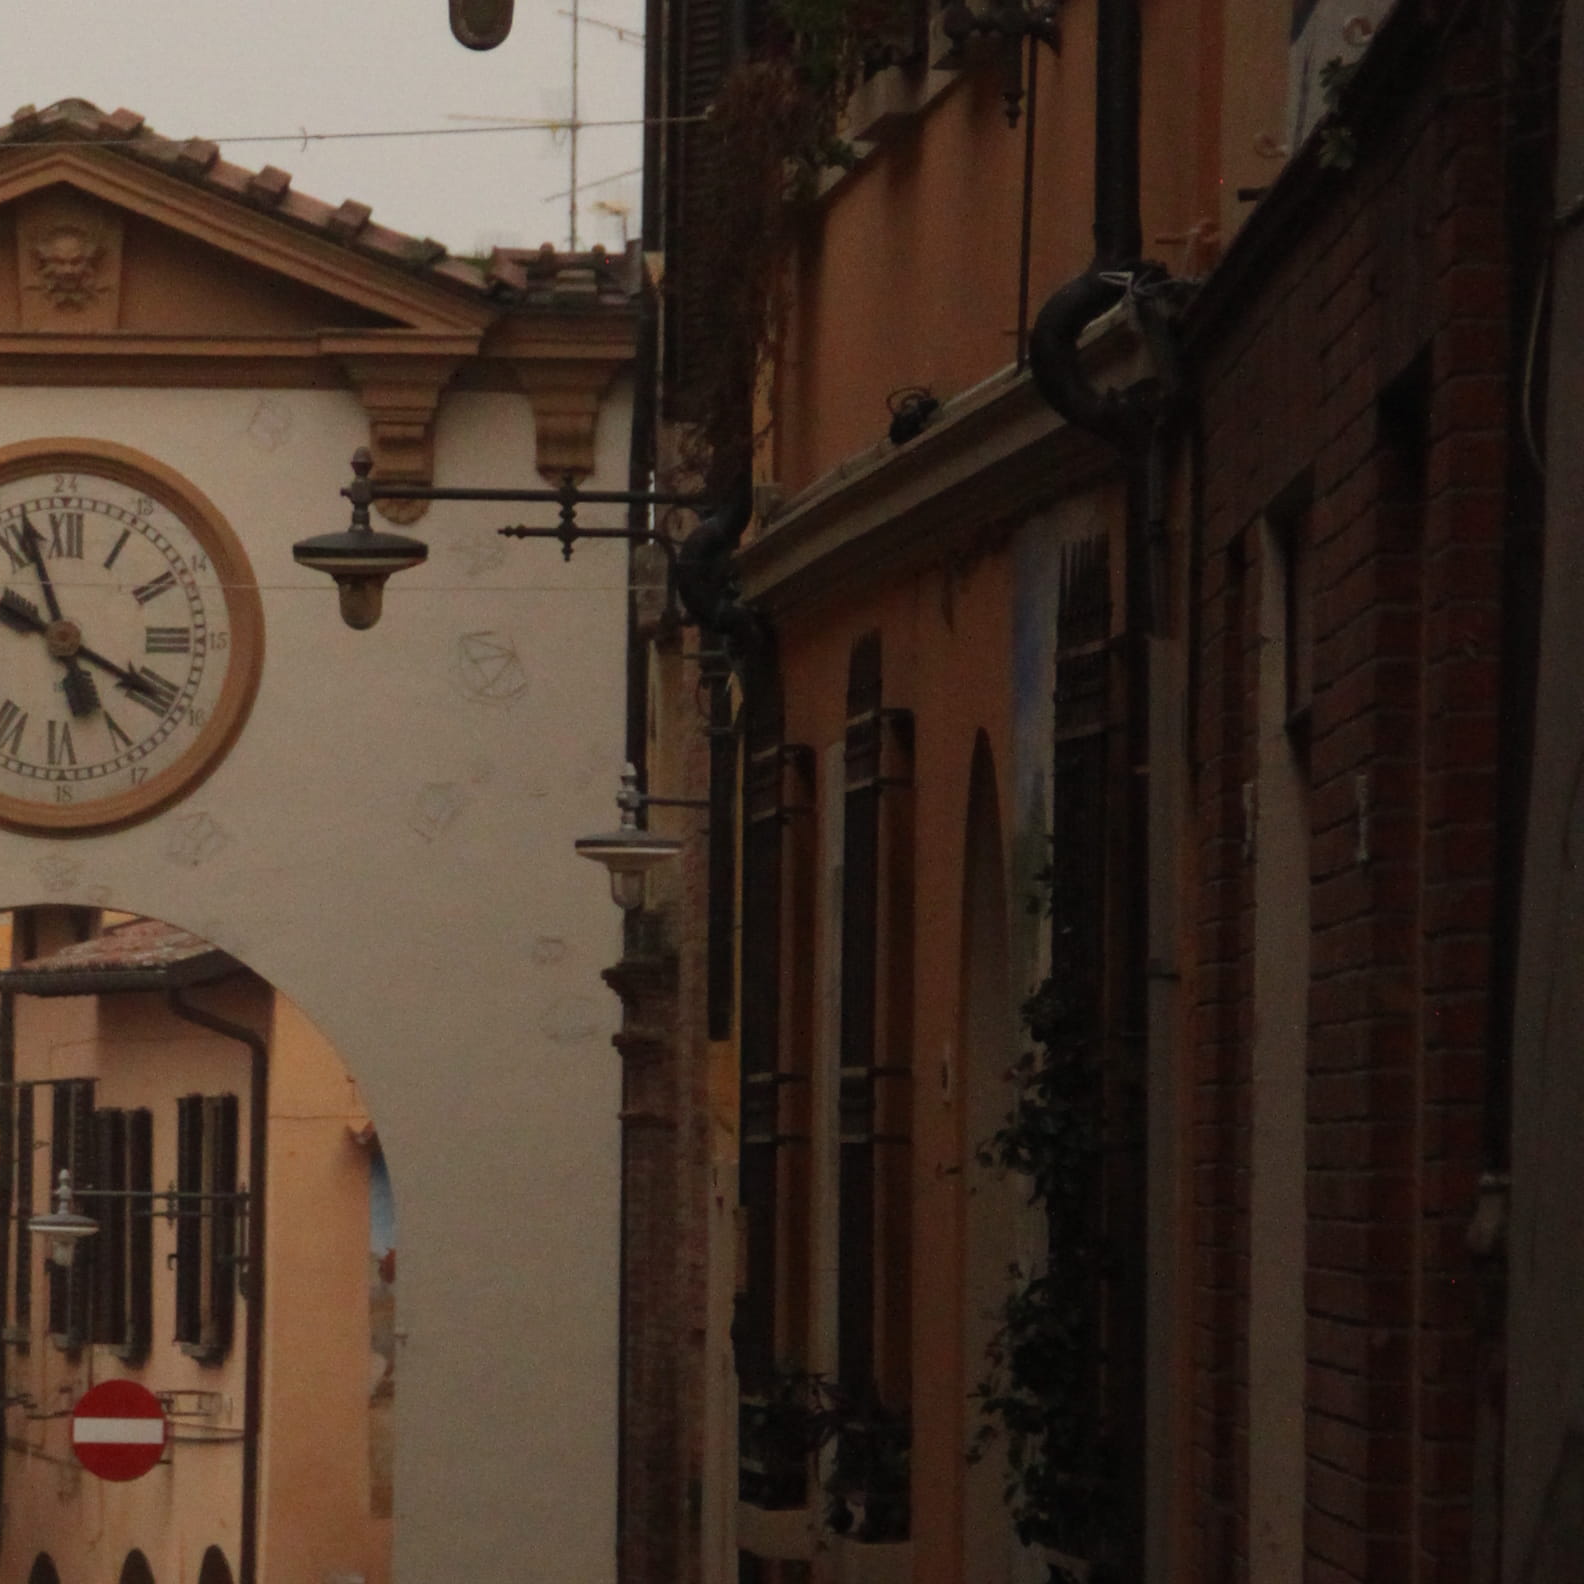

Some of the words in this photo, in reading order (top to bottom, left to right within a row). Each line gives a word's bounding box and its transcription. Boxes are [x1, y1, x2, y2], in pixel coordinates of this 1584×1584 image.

[54, 476, 78, 493] 24
[48, 513, 84, 559] XII
[103, 528, 130, 569] I
[133, 570, 177, 605] II
[146, 627, 190, 654] III
[210, 632, 227, 648] 15
[47, 720, 76, 765] VI
[131, 768, 148, 785] 17
[55, 785, 72, 802] 18
